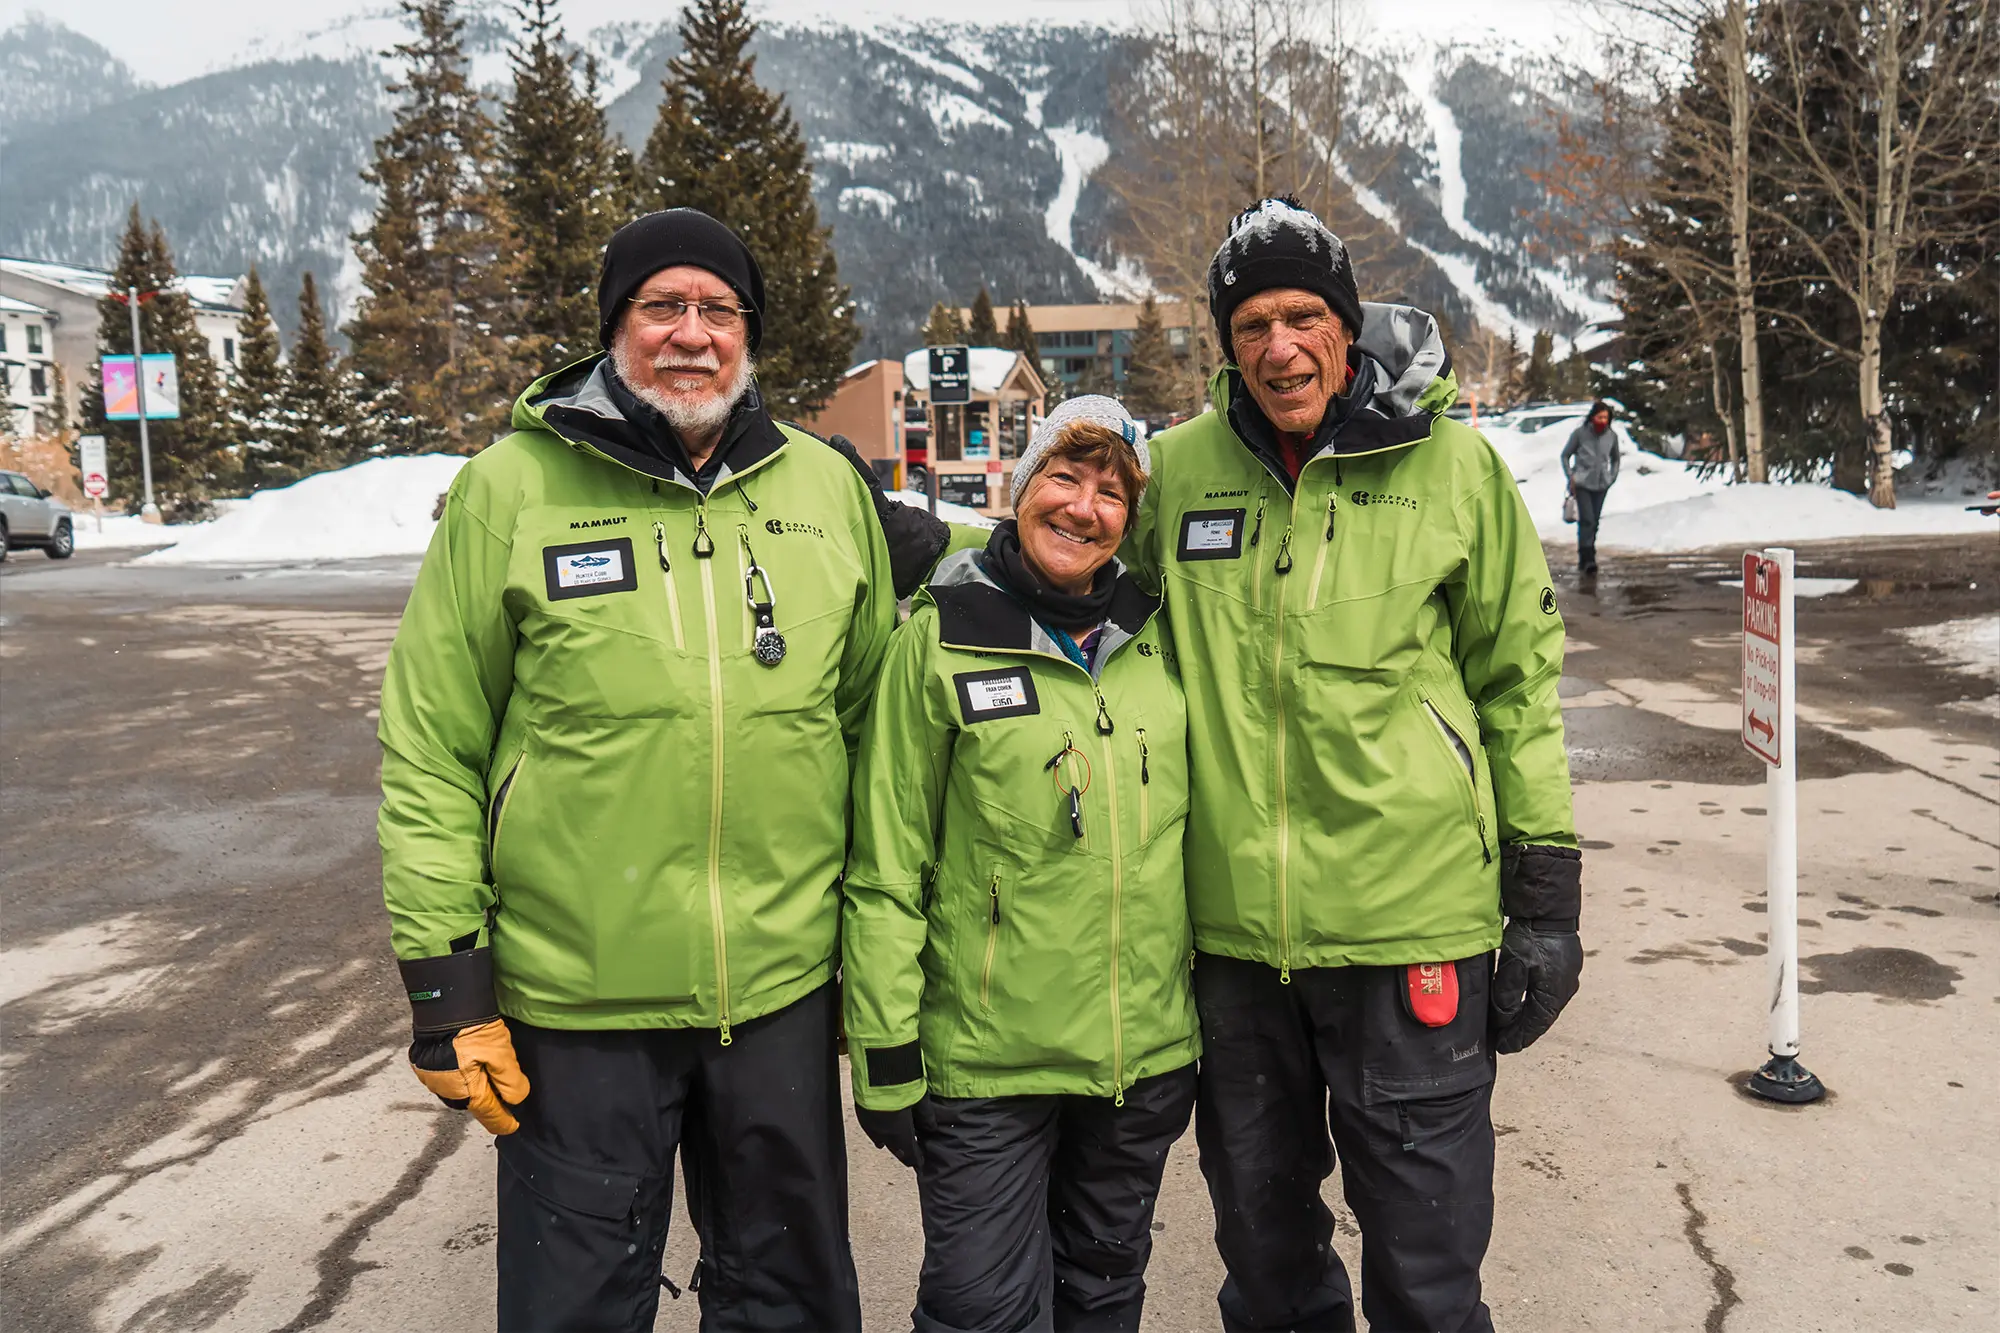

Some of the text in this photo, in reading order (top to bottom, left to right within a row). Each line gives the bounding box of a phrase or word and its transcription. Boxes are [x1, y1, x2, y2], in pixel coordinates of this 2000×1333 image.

[942, 356, 955, 372] P
[1204, 490, 1249, 499] MAMMUT
[1372, 494, 1417, 506] COPPER
[1372, 500, 1417, 511] MOUNTAIN
[569, 516, 628, 529] MAMMUT
[785, 522, 823, 534] COPPER
[1755, 560, 1769, 597] NO
[1746, 595, 1777, 640] PARKING
[1747, 643, 1777, 679] No Pick-Up
[1753, 675, 1777, 704] Drop-Off
